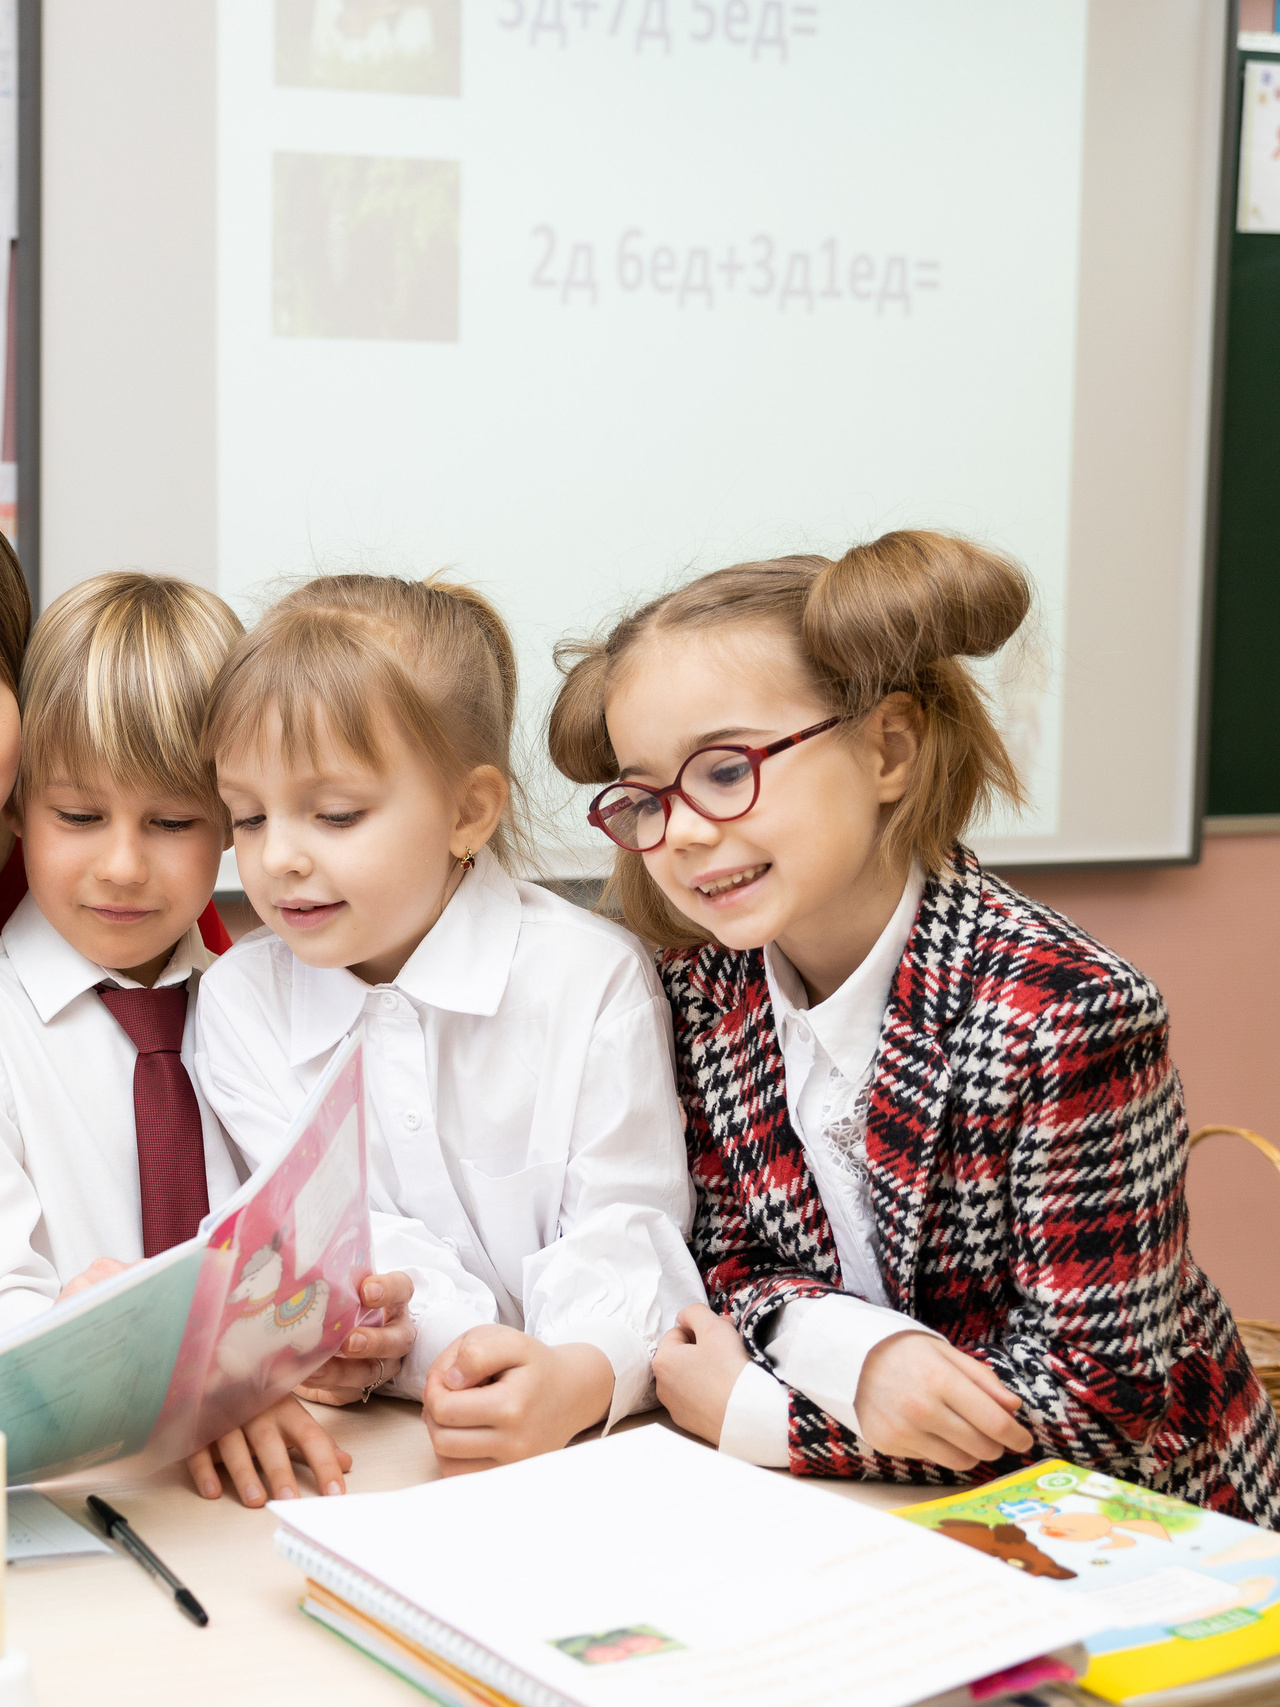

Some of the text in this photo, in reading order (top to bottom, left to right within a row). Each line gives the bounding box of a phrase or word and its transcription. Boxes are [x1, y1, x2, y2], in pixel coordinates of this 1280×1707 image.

[691, 0, 817, 61] 5ед=
[531, 225, 941, 315] 2д 6ед+3д1ед=
